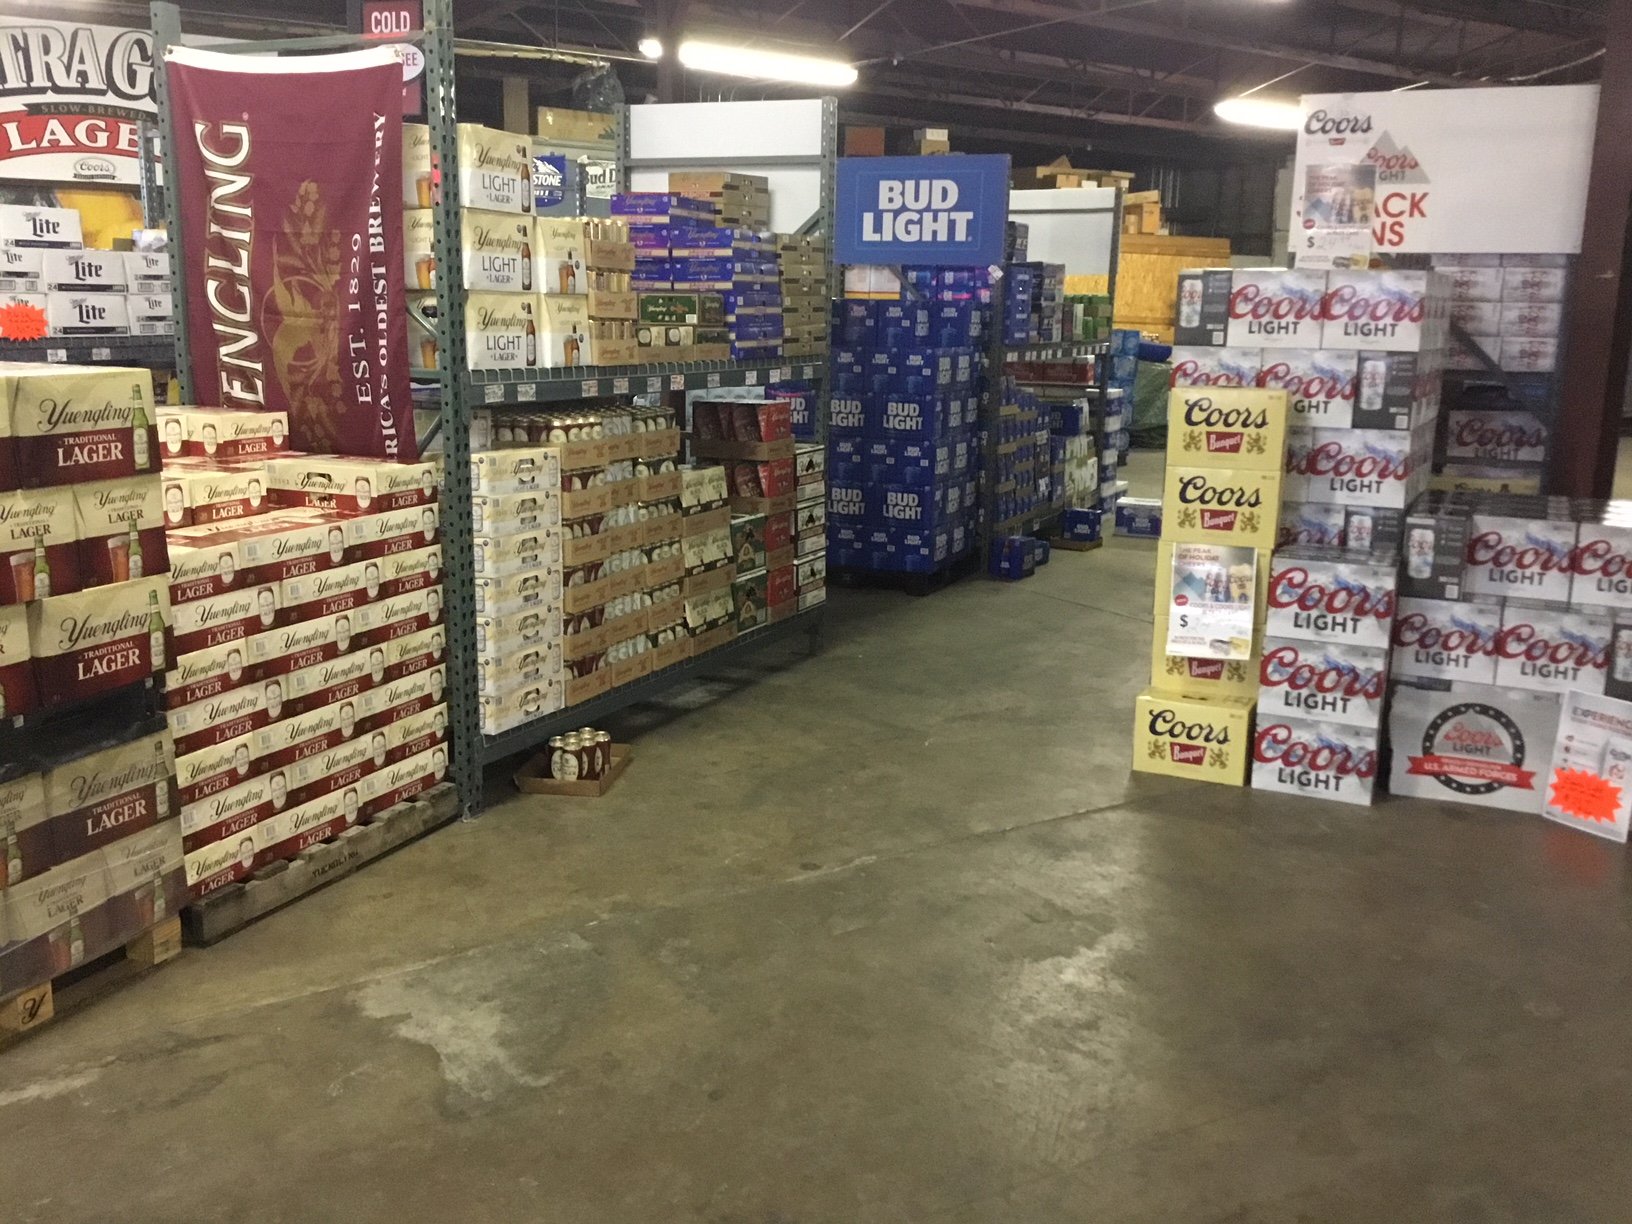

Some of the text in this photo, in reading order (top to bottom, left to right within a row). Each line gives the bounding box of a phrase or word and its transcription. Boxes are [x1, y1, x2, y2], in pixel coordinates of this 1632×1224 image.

[371, 11, 410, 33] COLD
[1304, 109, 1373, 135] Coors
[2, 118, 139, 151] LAGE
[474, 143, 520, 171] Yuengling
[368, 111, 387, 253] BREWERY
[482, 173, 517, 194] LIGHT
[533, 174, 562, 186] STONE
[1378, 170, 1408, 182] GHT
[878, 179, 959, 210] BUD
[31, 217, 60, 238] Lite
[862, 211, 974, 242] LIGHT
[473, 226, 520, 252] Yuengling
[5, 251, 23, 264] Lite
[145, 257, 159, 268] Lite
[482, 256, 517, 273] LIGHT
[74, 261, 102, 281] Lite
[148, 299, 162, 309] Lite
[1229, 284, 1326, 320] Coors
[1322, 285, 1426, 323] Coors
[78, 303, 106, 324] Lite
[347, 233, 373, 405] EST. 1829
[371, 262, 388, 367] OLDEST
[477, 306, 526, 331] Yuengling
[1248, 321, 1300, 335] LIGHT
[1343, 322, 1399, 337] LIGHT
[486, 335, 522, 351] LIGHT
[37, 398, 131, 432] Yuengling
[831, 399, 862, 413] BUD
[887, 402, 920, 416] BUD
[1184, 397, 1269, 429] Coors
[1294, 400, 1331, 415] GHT
[883, 416, 923, 430] LIGHT
[63, 433, 117, 445] TRADITIONAL
[239, 442, 267, 454] LAGER
[1209, 434, 1242, 450] Banquet
[57, 442, 124, 467] LAGER
[1309, 441, 1414, 481] Coors
[204, 485, 248, 501] Yuengling
[831, 487, 862, 501] BUD
[1178, 475, 1263, 508] Coors
[1329, 478, 1384, 494] LIGHT
[94, 489, 147, 509] Yuengling
[392, 495, 418, 508] LAGER
[828, 500, 866, 515] LIGHT
[887, 492, 919, 507] BUD
[108, 509, 144, 524] LAGER
[212, 505, 244, 519] LAGER
[882, 505, 922, 520] LIGHT
[1203, 512, 1235, 528] Banquet
[10, 523, 51, 540] LAGER
[376, 518, 418, 535] Yuengling
[272, 537, 322, 560] Yuengling
[385, 540, 412, 554] LAGER
[1467, 531, 1577, 573] Coors
[171, 561, 219, 582] Yuengling
[283, 561, 316, 578] LAGER
[1488, 567, 1546, 586] LIGHT
[177, 583, 214, 601] LAGER
[313, 576, 360, 597] Yuengling
[398, 578, 424, 593] LAGER
[1268, 566, 1396, 619] Coors
[195, 600, 251, 626] Yuengling
[322, 598, 354, 615] LAGER
[58, 610, 150, 650] Yuengling
[390, 622, 418, 640] LAGER
[1180, 614, 1188, 628] $
[1293, 612, 1362, 635] LIGHT
[207, 625, 245, 646] LAGER
[280, 628, 330, 653] Yuengling
[1392, 612, 1502, 657] Coors
[83, 640, 134, 659] TRADITIONAL
[1494, 624, 1612, 670] Coors
[77, 648, 141, 681] LAGER
[290, 652, 323, 671] LAGER
[402, 658, 428, 675] LAGER
[1191, 660, 1222, 676] Banquet
[1414, 651, 1472, 669] LIGHT
[176, 661, 227, 683] Yuengling
[320, 661, 365, 686] Yuengling
[1258, 646, 1385, 700] Coors
[1520, 661, 1580, 681] LIGHT
[186, 681, 222, 702] LAGER
[328, 684, 359, 704] LAGER
[1284, 690, 1351, 714] LIGHT
[203, 696, 258, 725] Yuengling
[393, 703, 421, 721] LAGER
[216, 720, 253, 742] LAGER
[285, 716, 334, 744] Yuengling
[1148, 708, 1231, 745] Coors
[1443, 720, 1504, 747] Coors
[295, 741, 328, 761] LAGER
[405, 739, 431, 757] LAGER
[1173, 744, 1204, 761] Banquet
[1252, 724, 1377, 778] Coors
[1451, 743, 1491, 756] LIGHT
[185, 755, 235, 781] Yuengling
[1423, 761, 1440, 771] U.S.
[1444, 763, 1478, 776] ARMED
[1479, 768, 1518, 782] FORCES
[69, 763, 158, 808] Yuengling
[195, 777, 230, 800] LAGER
[330, 769, 361, 791] LAGER
[1277, 767, 1344, 792] LIGHT
[395, 783, 423, 803] LAGER
[210, 788, 263, 821] Yuengling
[86, 799, 147, 836] LAGER
[221, 813, 258, 838] LAGER
[289, 803, 339, 833] Yuengling
[300, 825, 332, 850] LAGER
[191, 849, 239, 878] Yuengling
[201, 870, 235, 896] LAGER
